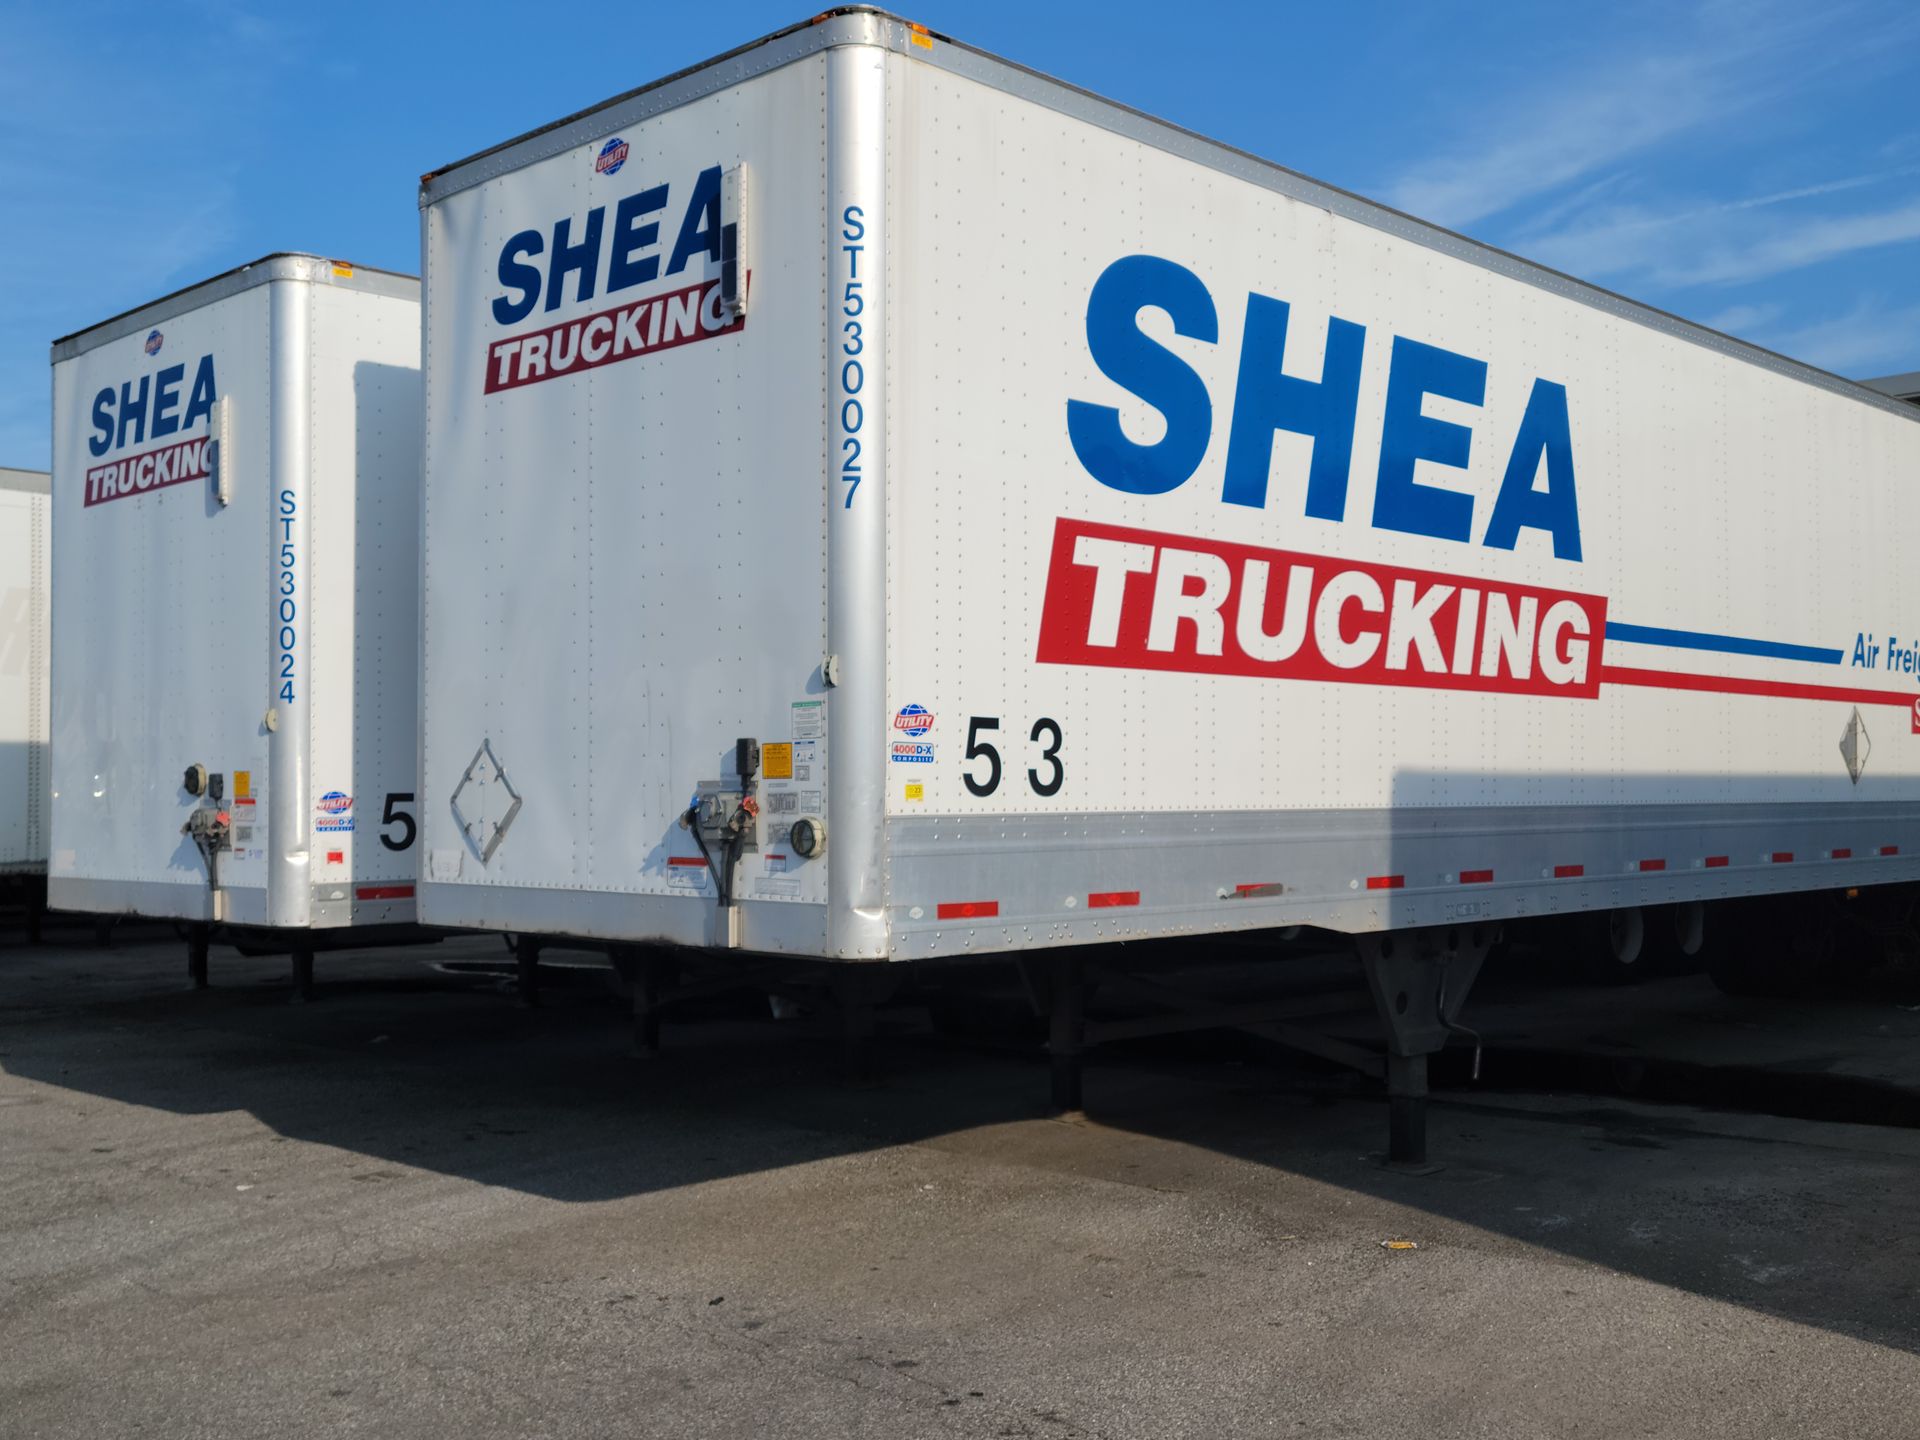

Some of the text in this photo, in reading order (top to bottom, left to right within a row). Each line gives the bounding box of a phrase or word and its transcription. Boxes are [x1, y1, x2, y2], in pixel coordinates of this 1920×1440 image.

[598, 146, 627, 169] UTILITY
[492, 164, 722, 326] SHEA
[89, 353, 216, 457] SHEA
[841, 206, 865, 509] ST530027
[1067, 254, 1583, 562] SHEA
[279, 490, 296, 704] ST530024
[1072, 535, 1591, 684] TRUCKING
[1852, 632, 1880, 669] Air
[893, 745, 932, 755] 4000D-X
[896, 716, 932, 728] UTILITY
